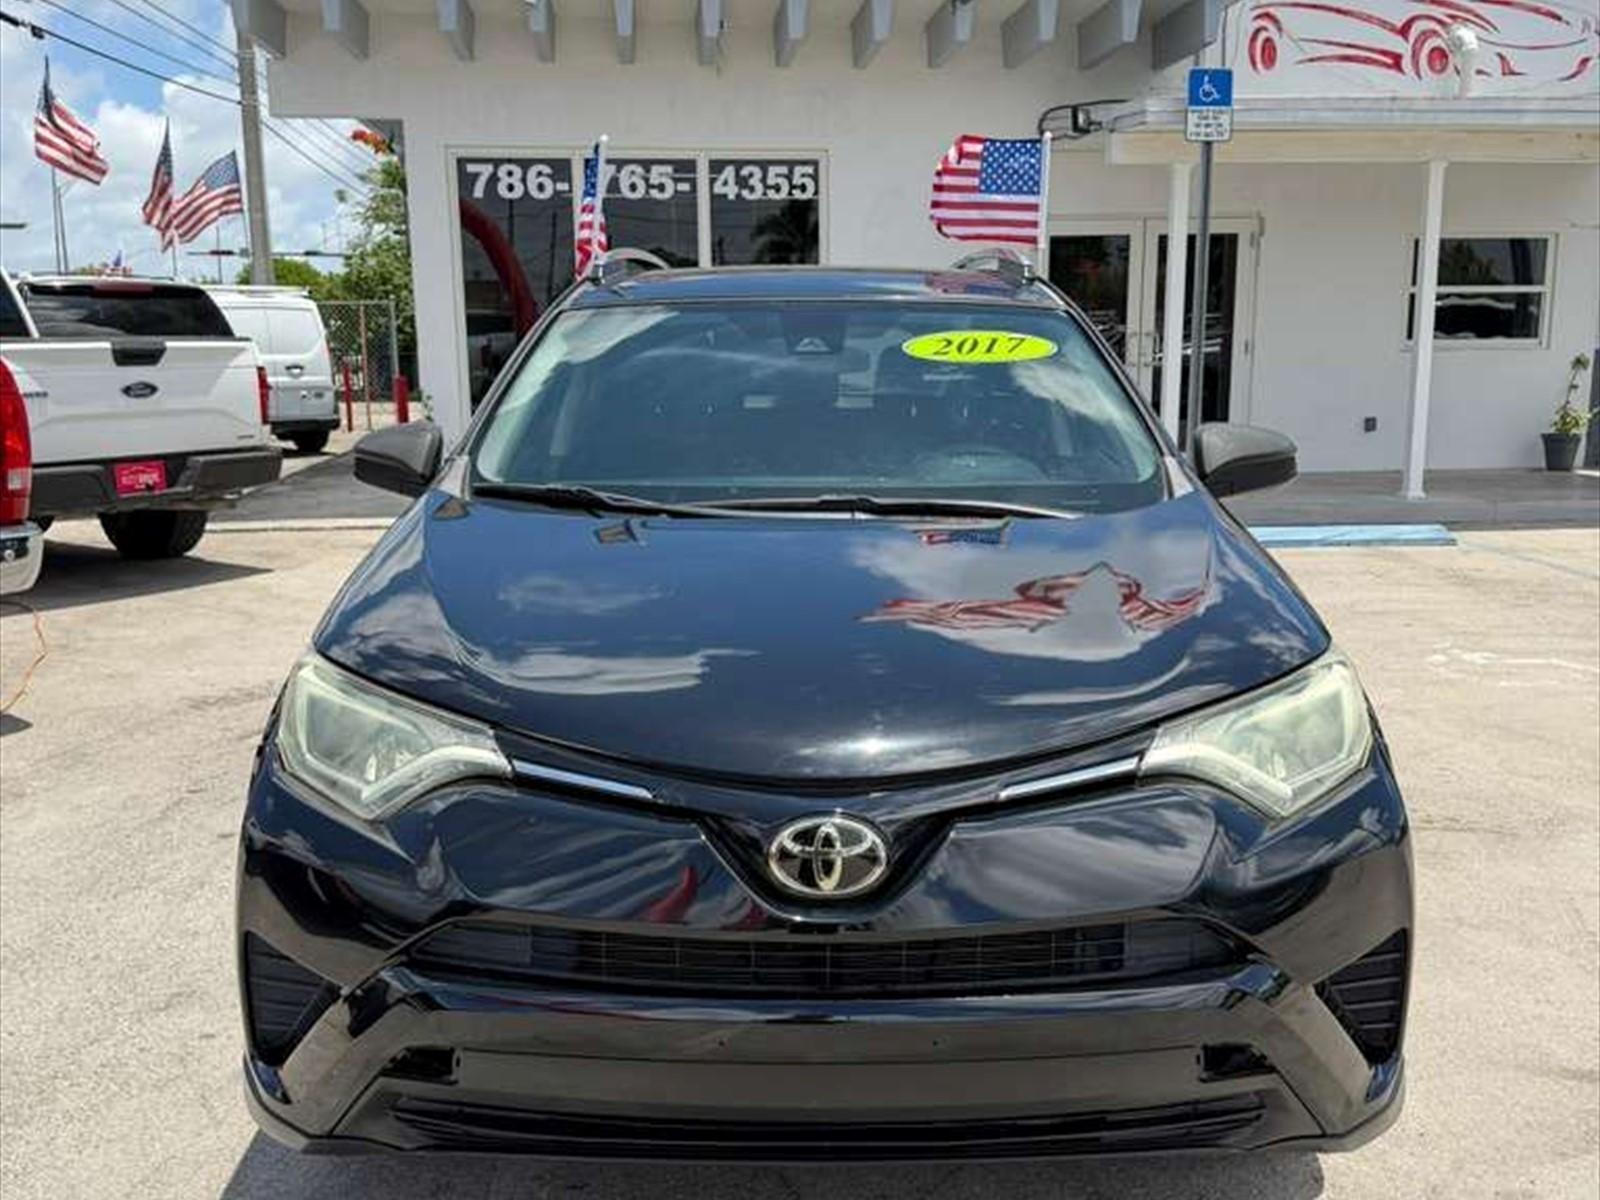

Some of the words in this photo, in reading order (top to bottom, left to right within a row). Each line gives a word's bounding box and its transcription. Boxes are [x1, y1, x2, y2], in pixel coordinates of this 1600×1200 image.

[466, 164, 570, 200] 786-
[713, 165, 816, 200] 4355
[932, 337, 1026, 356] 2017
